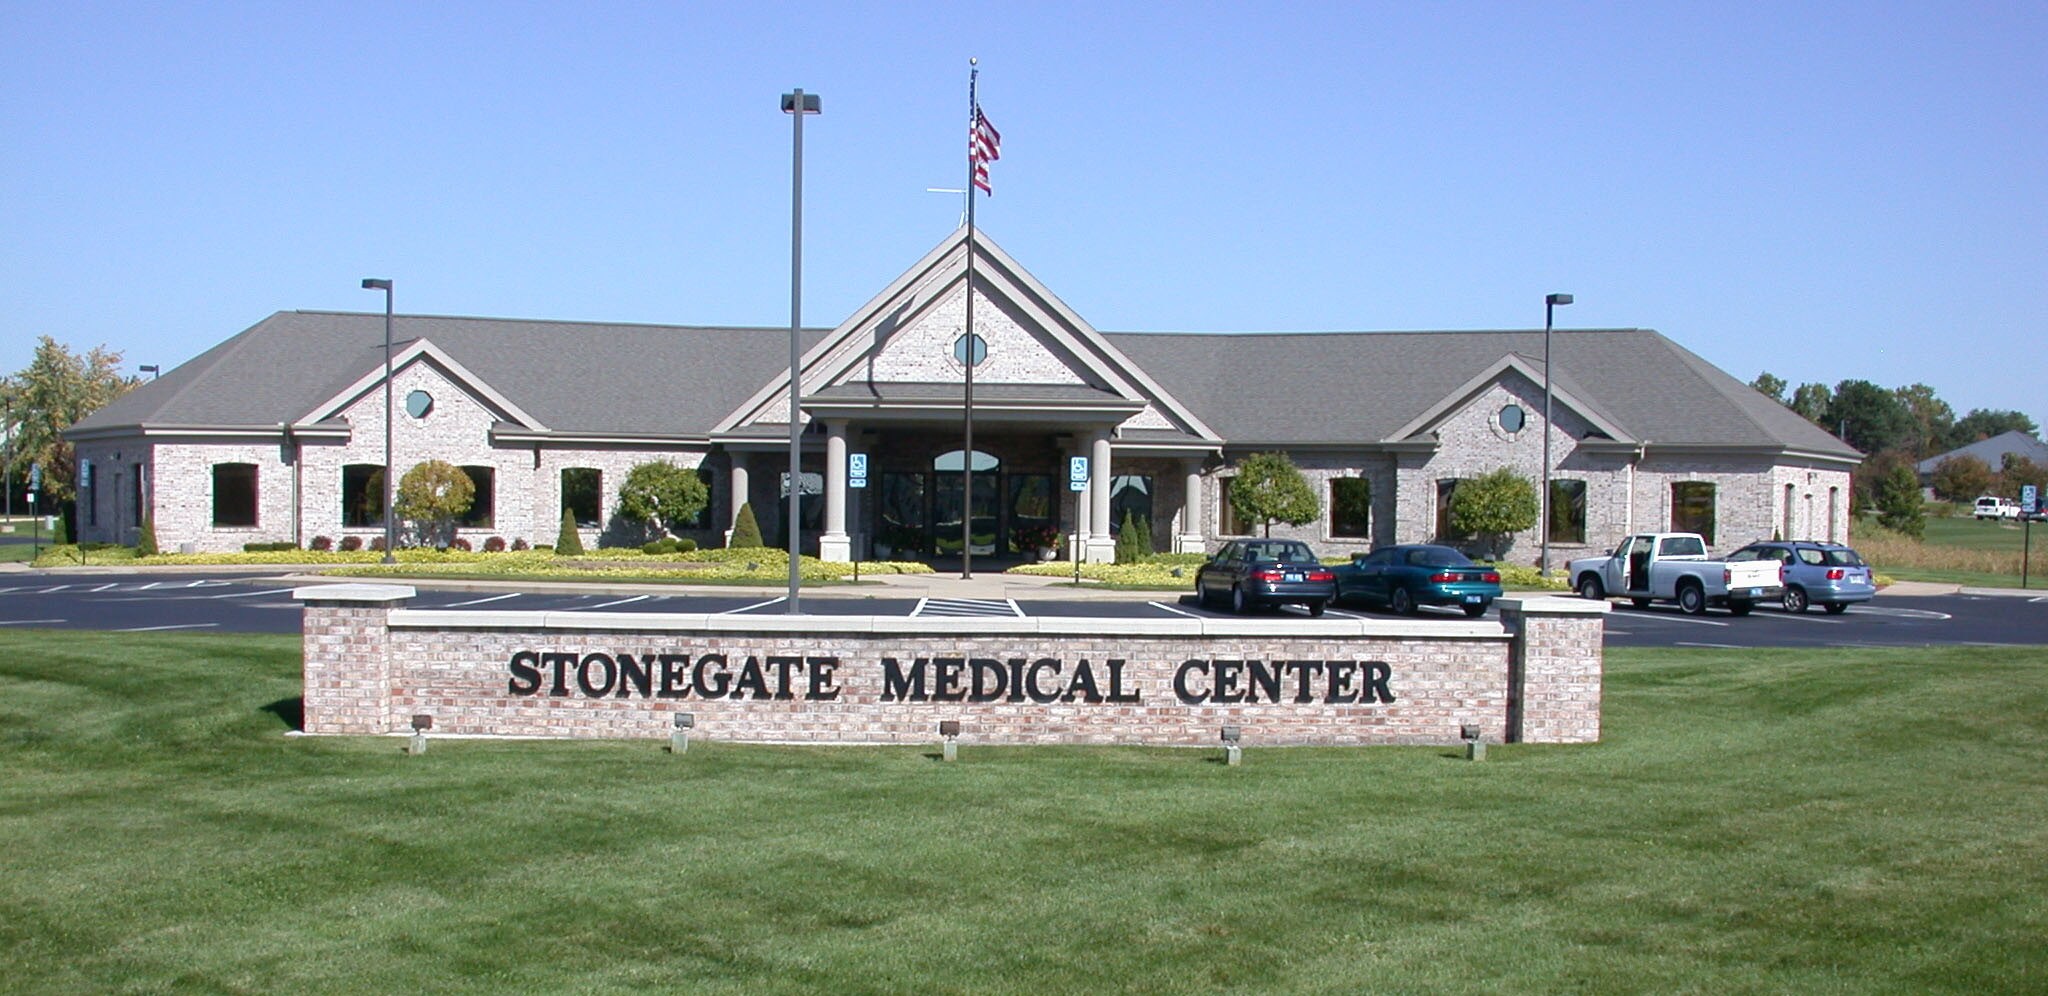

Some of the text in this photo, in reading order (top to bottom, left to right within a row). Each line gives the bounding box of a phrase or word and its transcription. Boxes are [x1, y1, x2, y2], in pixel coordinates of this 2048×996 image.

[508, 651, 1396, 706] STONEGATE MEDICAL CENTER
